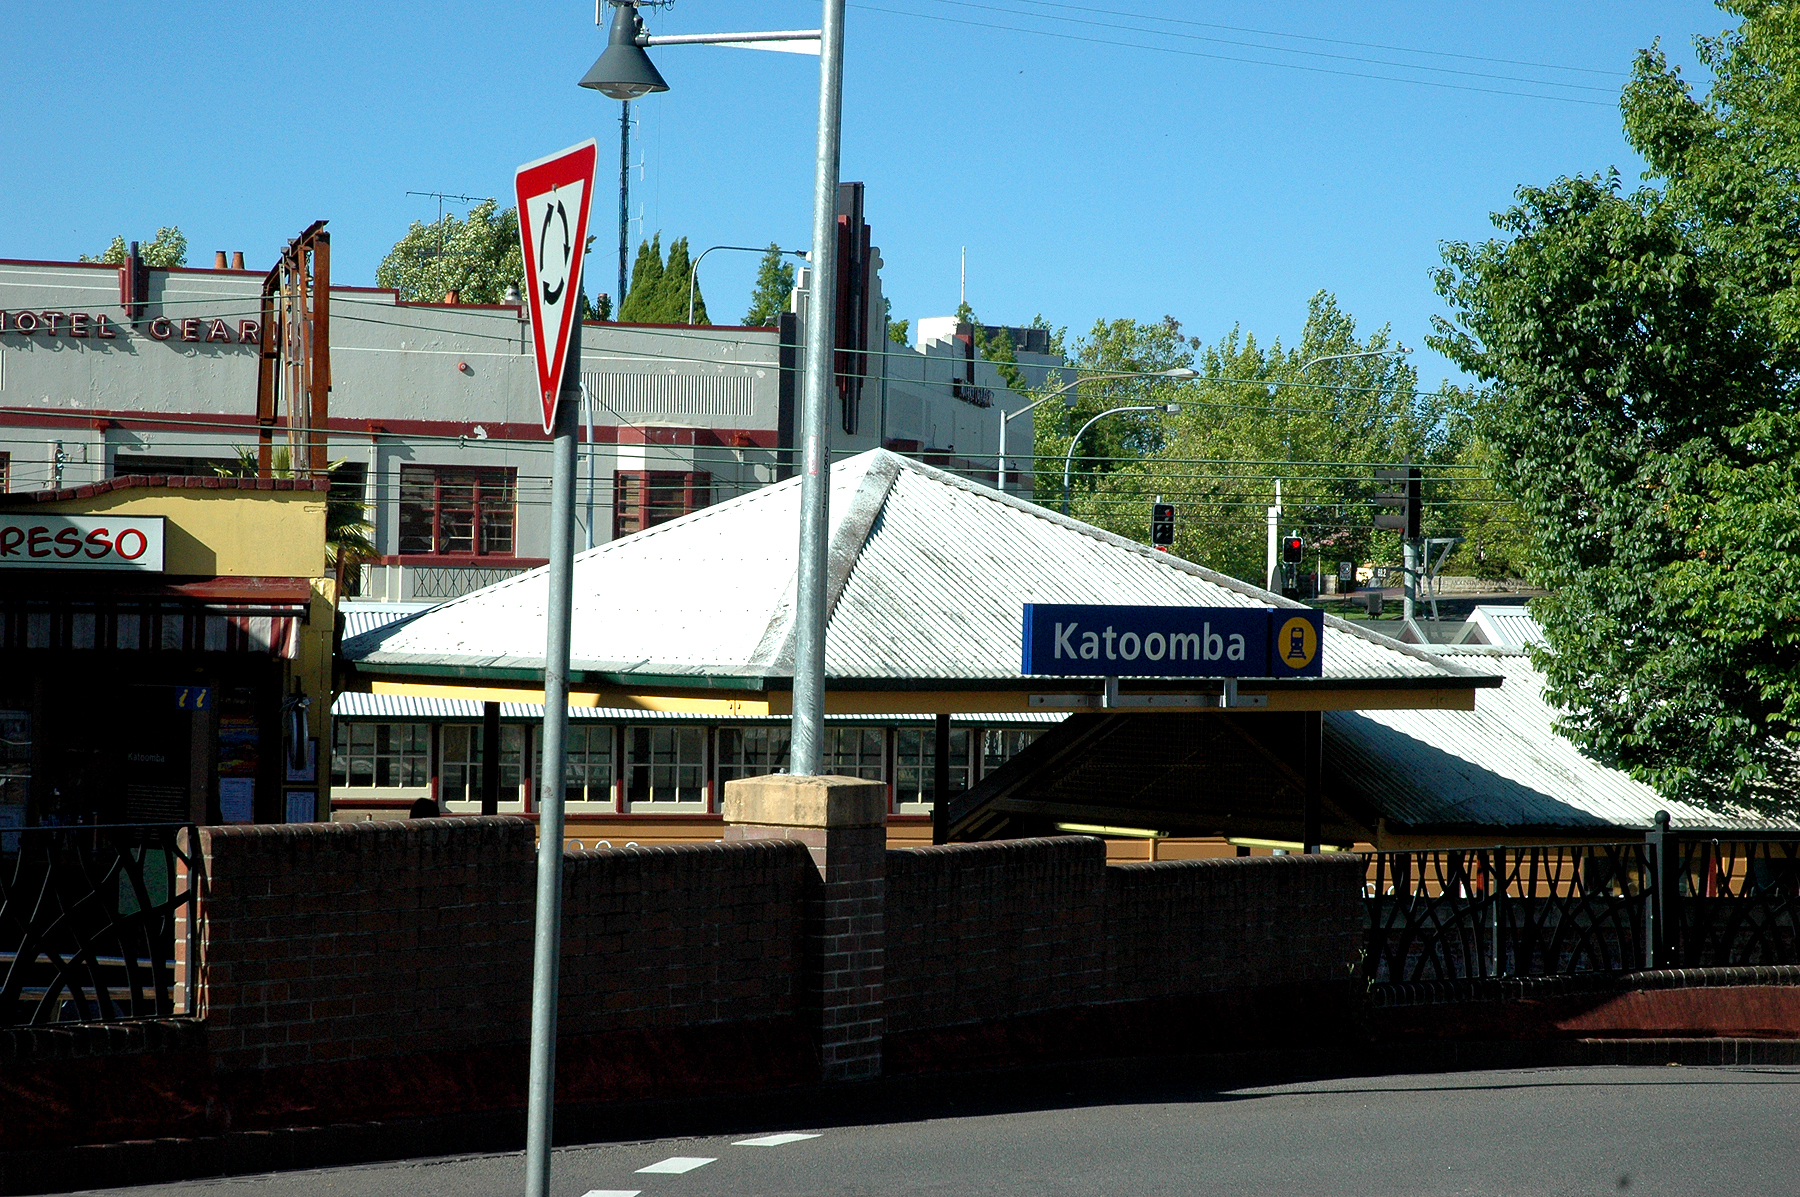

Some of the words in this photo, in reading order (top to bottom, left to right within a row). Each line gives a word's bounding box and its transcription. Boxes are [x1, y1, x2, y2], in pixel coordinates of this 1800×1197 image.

[0, 526, 148, 560] RESSO
[1054, 622, 1246, 661] Katoomba
[127, 752, 165, 763] Katoomba
